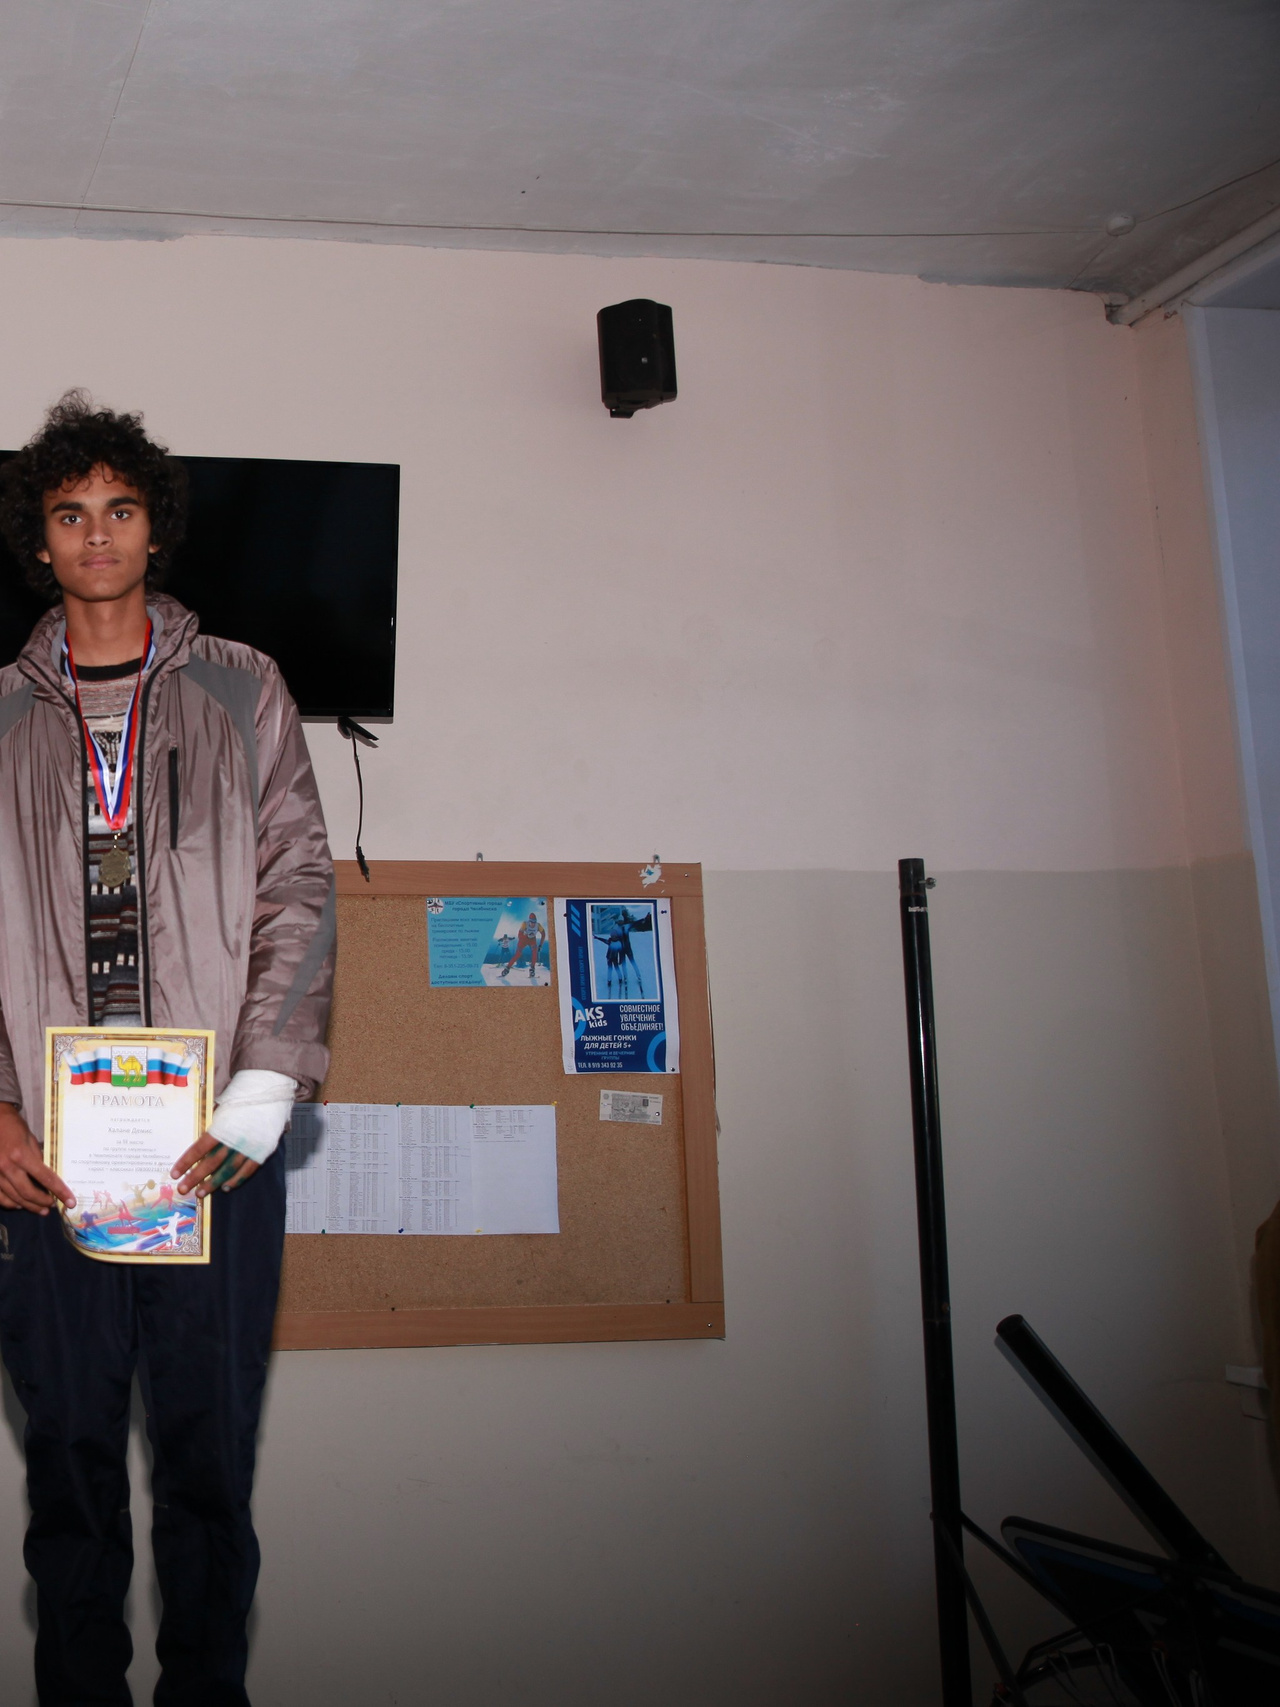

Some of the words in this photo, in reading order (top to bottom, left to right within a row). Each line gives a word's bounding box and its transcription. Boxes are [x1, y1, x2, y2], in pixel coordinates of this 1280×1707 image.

[620, 1004, 660, 1013] СОВМЕСТНОЕ
[574, 1006, 604, 1023] AKS
[620, 1014, 656, 1022] УВЛЕЧЕНИЕ
[589, 1019, 608, 1028] kids
[621, 1023, 664, 1031] ОБЪЕДИНЯЕТ!
[600, 1041, 622, 1049] ДЕТЕЙ
[92, 1094, 165, 1106] ГРАМОТА
